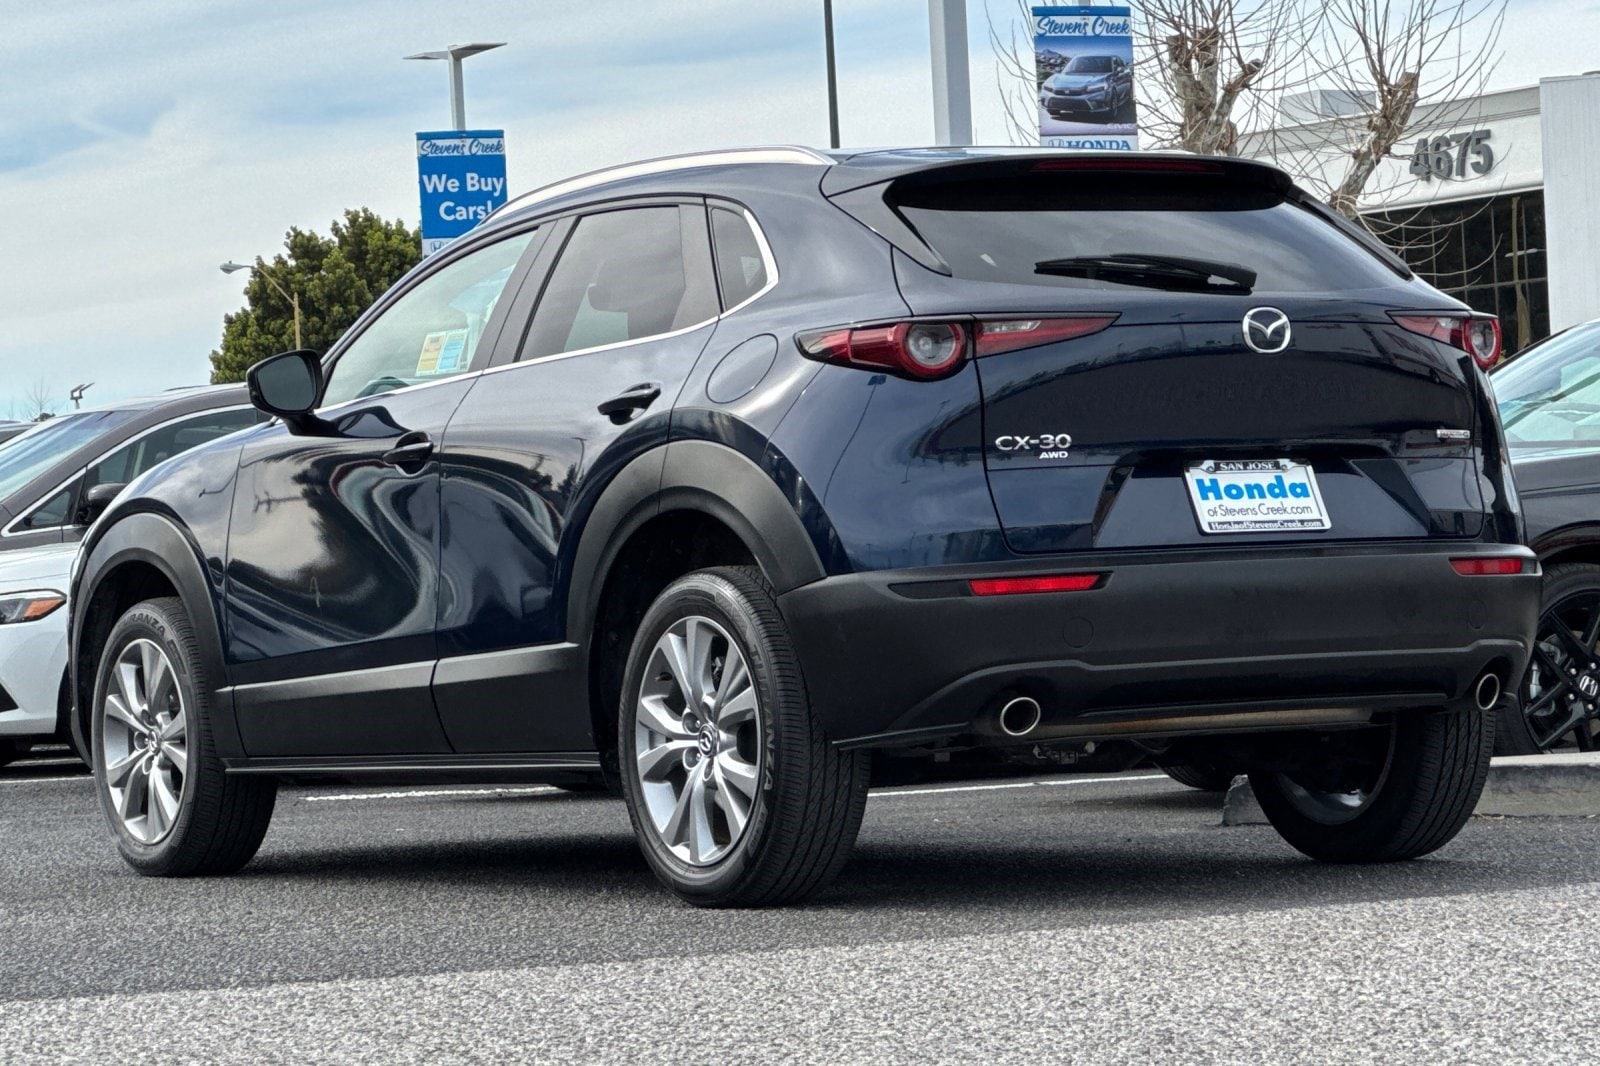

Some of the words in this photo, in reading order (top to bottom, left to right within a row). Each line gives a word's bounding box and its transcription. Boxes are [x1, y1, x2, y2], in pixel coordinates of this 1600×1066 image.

[1036, 16, 1089, 37] Stevens
[1091, 16, 1130, 36] Creek
[421, 140, 466, 157] Stevens
[468, 139, 504, 155] Creek
[1067, 140, 1131, 150] HONDA
[1409, 129, 1494, 182] 4675
[422, 174, 460, 193] We
[465, 172, 504, 197] Buy
[995, 433, 1072, 451] CX-30
[1039, 451, 1069, 459] AWD
[1219, 461, 1244, 471] SAN
[1245, 461, 1277, 470] JOSE
[1195, 475, 1311, 501] Honda
[1207, 506, 1219, 517] of
